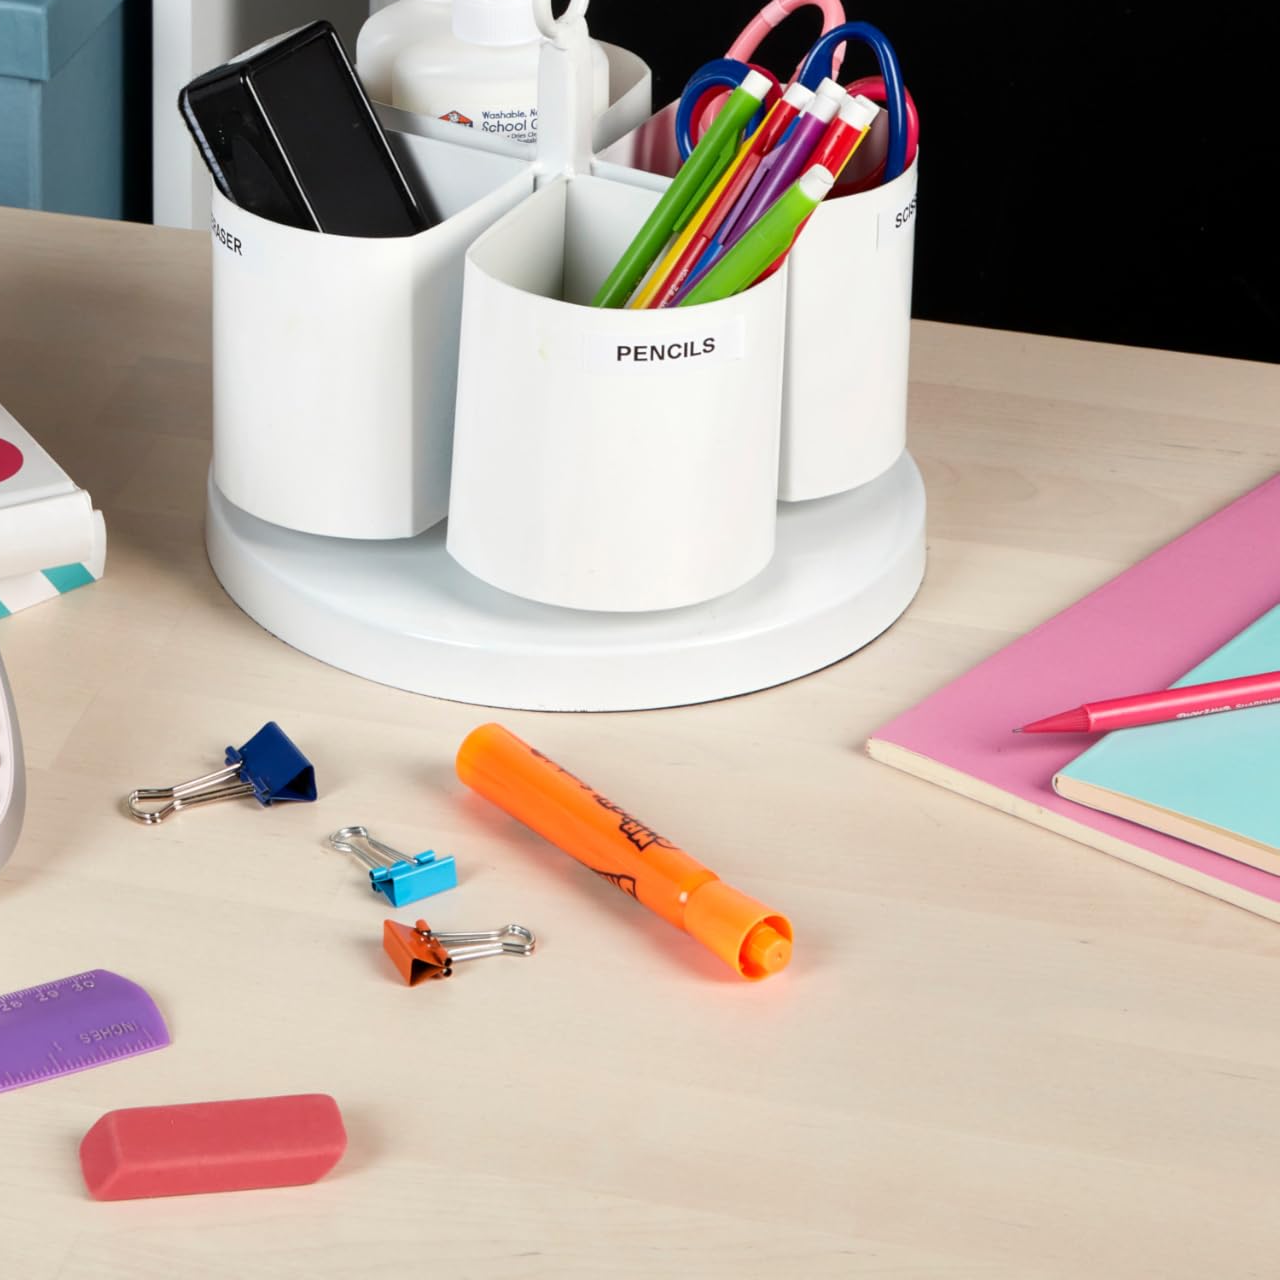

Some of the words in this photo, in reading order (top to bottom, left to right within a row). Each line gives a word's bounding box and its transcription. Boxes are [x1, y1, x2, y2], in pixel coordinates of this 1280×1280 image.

[481, 120, 527, 132] School
[616, 337, 716, 362] PENCILS
[0, 999, 23, 1012] 28
[35, 989, 60, 1001] 29
[71, 980, 95, 992] 30
[79, 1022, 138, 1045] INCHES
